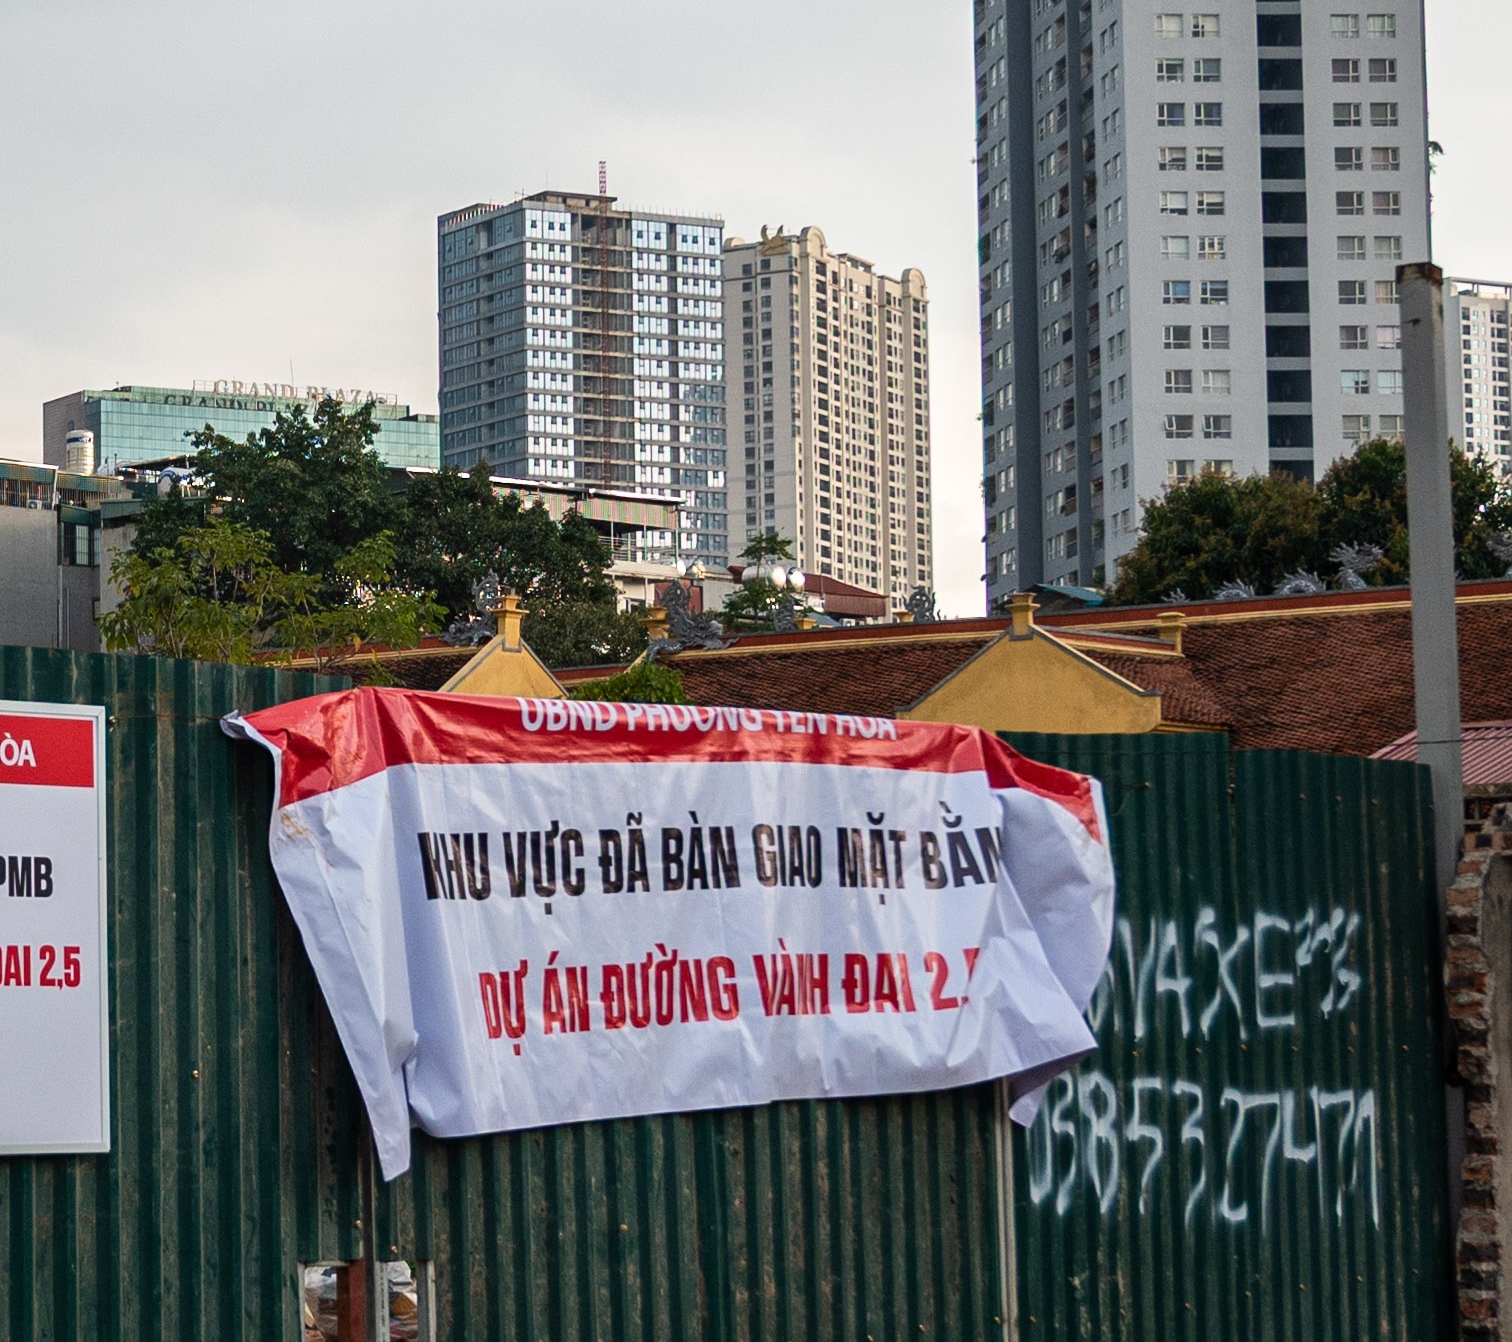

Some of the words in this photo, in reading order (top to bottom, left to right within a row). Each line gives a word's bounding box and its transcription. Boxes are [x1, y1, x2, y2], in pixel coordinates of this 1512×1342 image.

[213, 379, 295, 399] GRAND
[416, 830, 490, 901] KHU
[502, 820, 584, 915] VỰC
[598, 811, 650, 895] ĐÃ
[661, 809, 741, 892] BÀN
[753, 822, 823, 889] GIAO
[838, 811, 908, 906] MẶT
[920, 800, 1006, 890] BẰN
[39, 946, 81, 991] 2,5
[478, 959, 527, 1056] DỰ
[541, 950, 590, 1035] ÁN
[599, 942, 737, 1030] ĐƯỜNG
[753, 937, 831, 1017] VÀNH
[841, 952, 916, 1015] ĐAI
